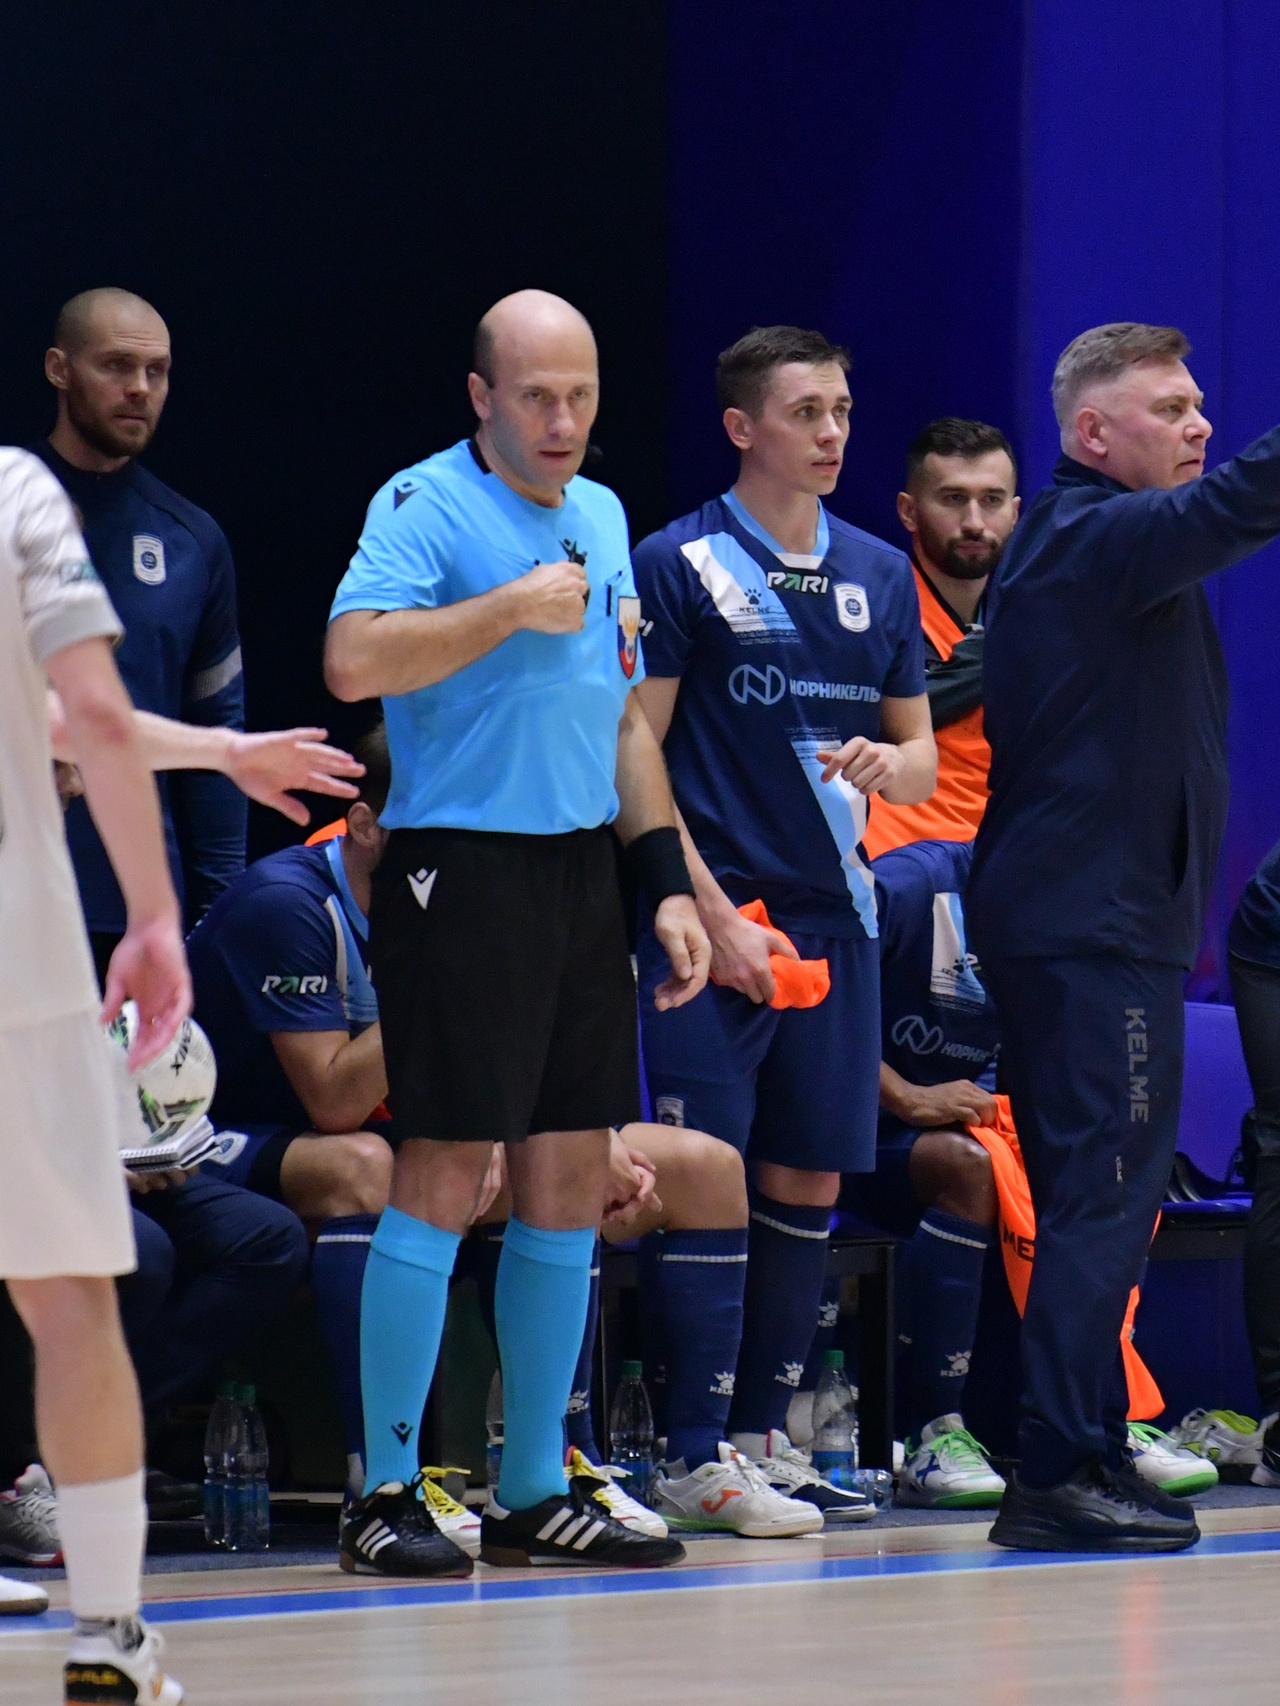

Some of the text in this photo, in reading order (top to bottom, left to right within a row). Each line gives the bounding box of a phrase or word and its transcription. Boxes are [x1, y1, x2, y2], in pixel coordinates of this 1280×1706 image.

[767, 572, 829, 594] PARI
[789, 679, 882, 703] НОРНИКЕЛЬ
[261, 974, 328, 994] PARI
[1125, 1008, 1149, 1124] KELME
